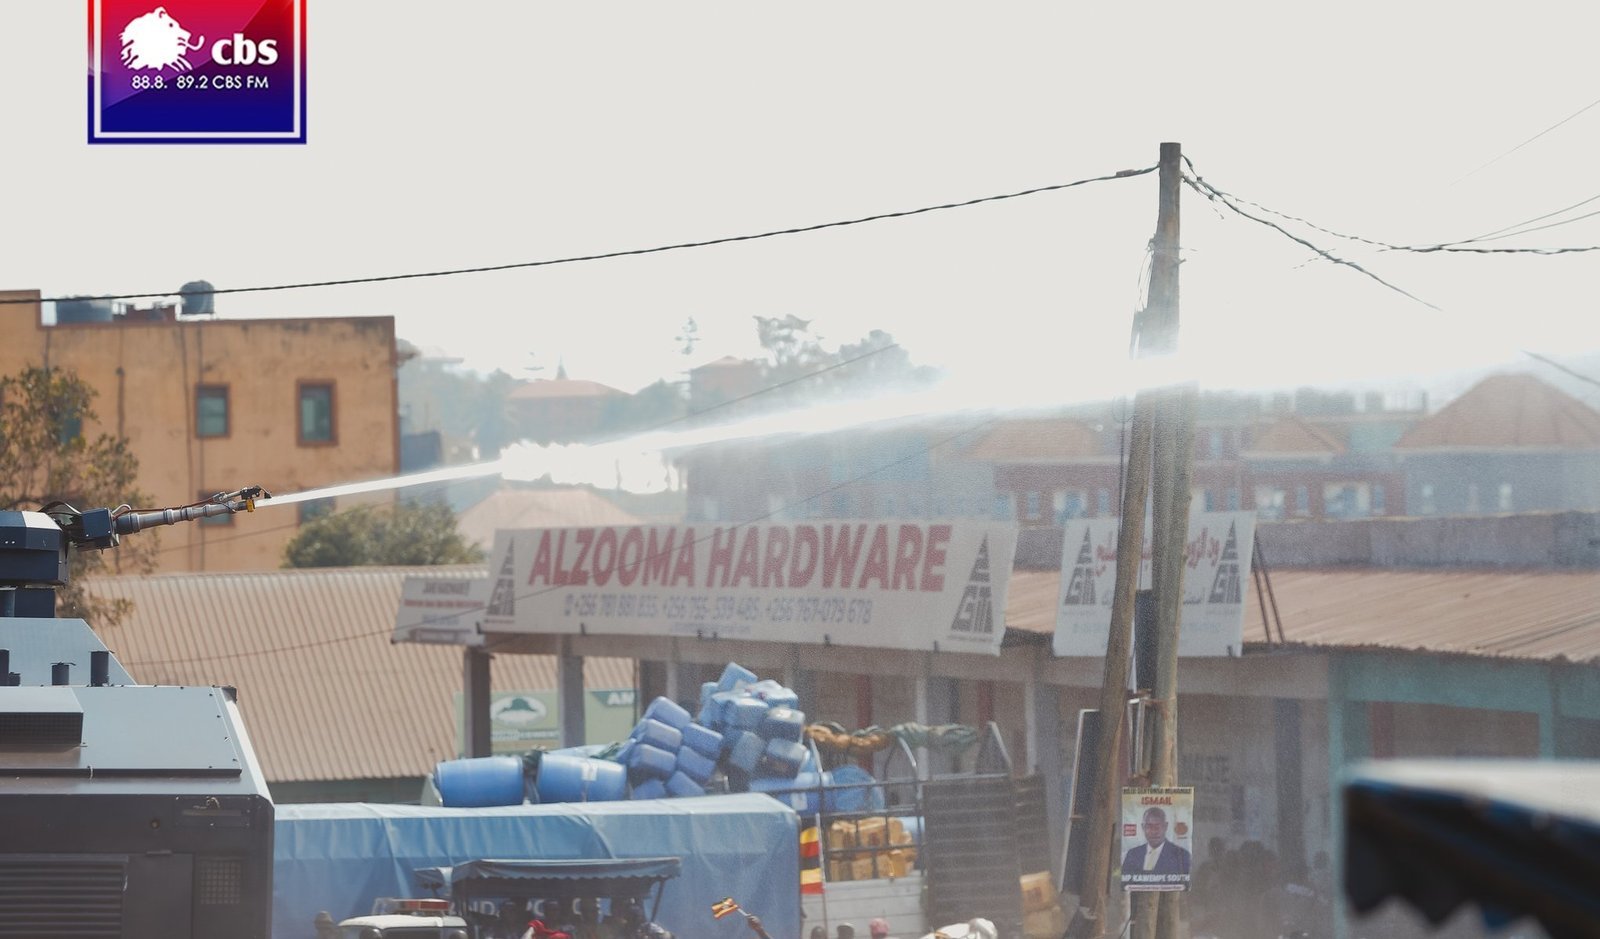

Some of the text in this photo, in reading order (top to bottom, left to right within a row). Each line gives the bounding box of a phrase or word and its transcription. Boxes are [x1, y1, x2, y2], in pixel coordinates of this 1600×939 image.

[528, 524, 953, 592] ALZOOMA HARDWARE
[1141, 796, 1173, 806] ISMAIL
[1121, 874, 1191, 882] MP KAWEMPE SOUTH
